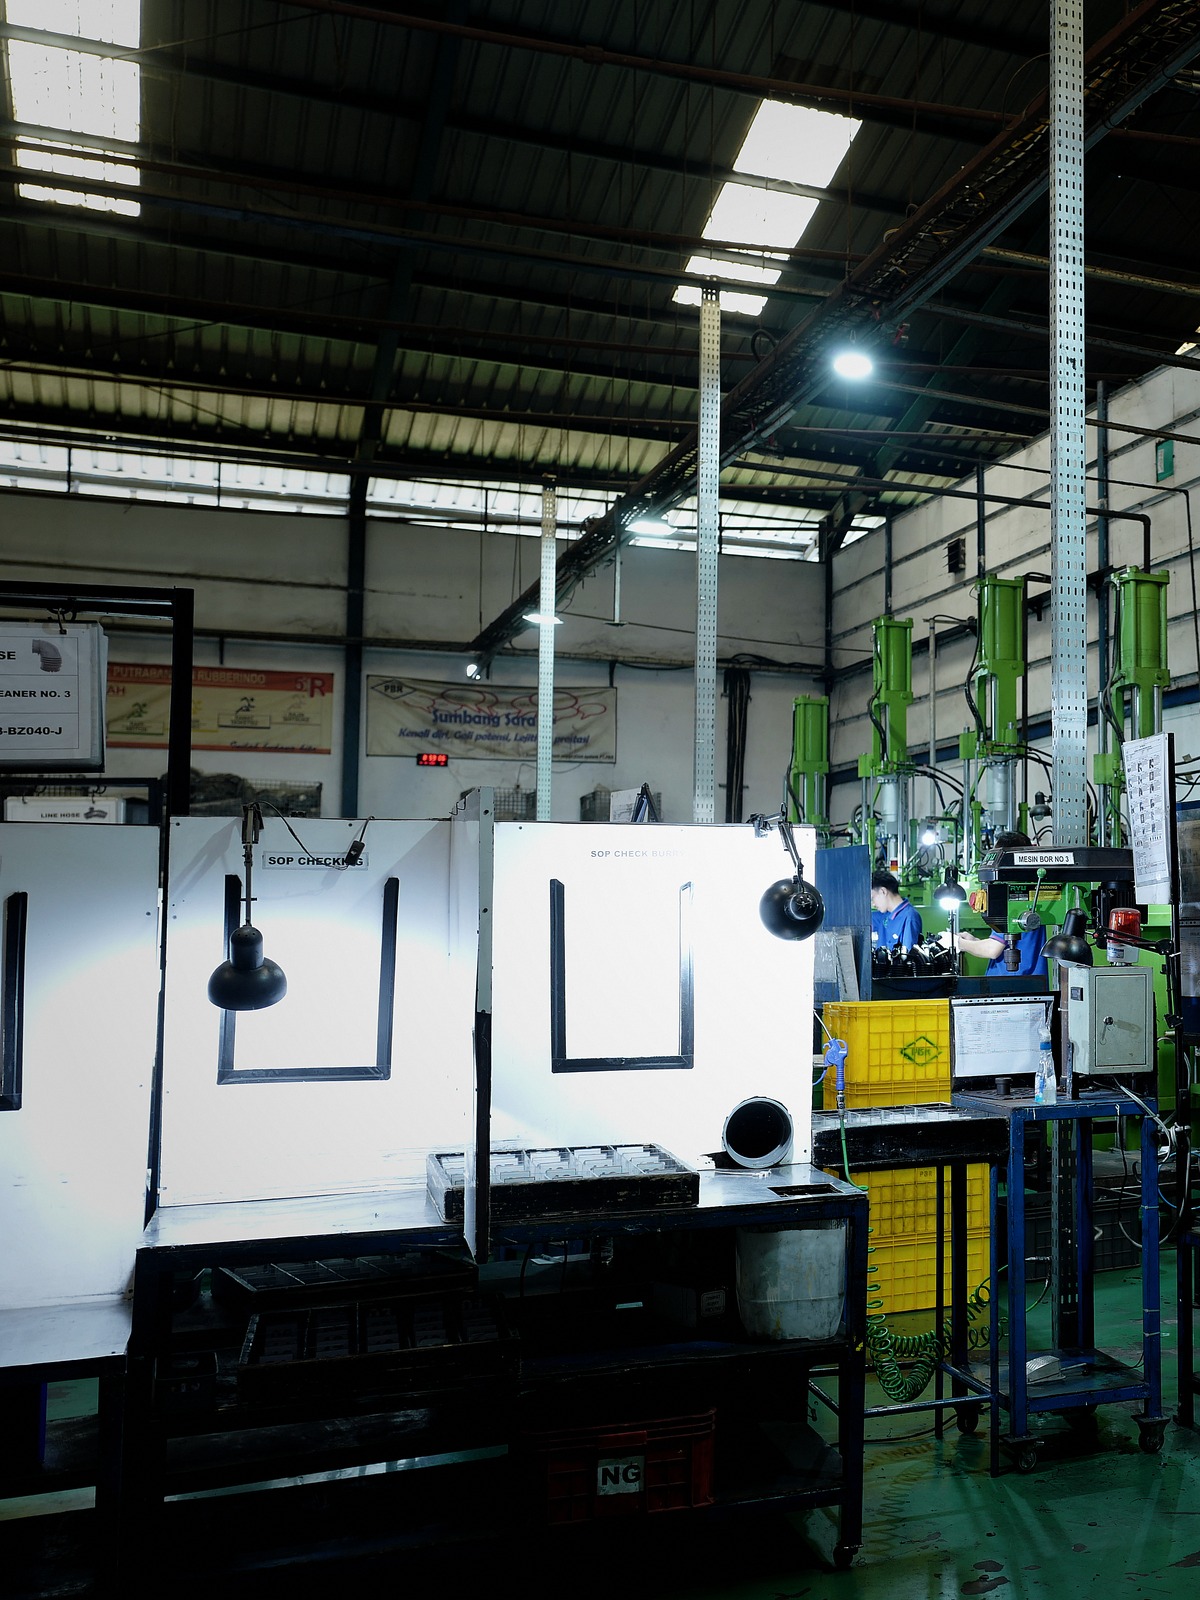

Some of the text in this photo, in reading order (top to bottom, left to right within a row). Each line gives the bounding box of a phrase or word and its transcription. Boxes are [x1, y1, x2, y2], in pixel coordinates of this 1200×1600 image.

[384, 684, 403, 693] PBR
[40, 690, 61, 698] NO.
[64, 690, 71, 698] 3
[432, 709, 500, 728] Sumbang
[591, 850, 611, 858] SOP
[614, 850, 648, 858] CHECK
[268, 856, 294, 865] SOP
[1018, 855, 1070, 863] MESIN BOR NO 3
[601, 1463, 641, 1486] NG
